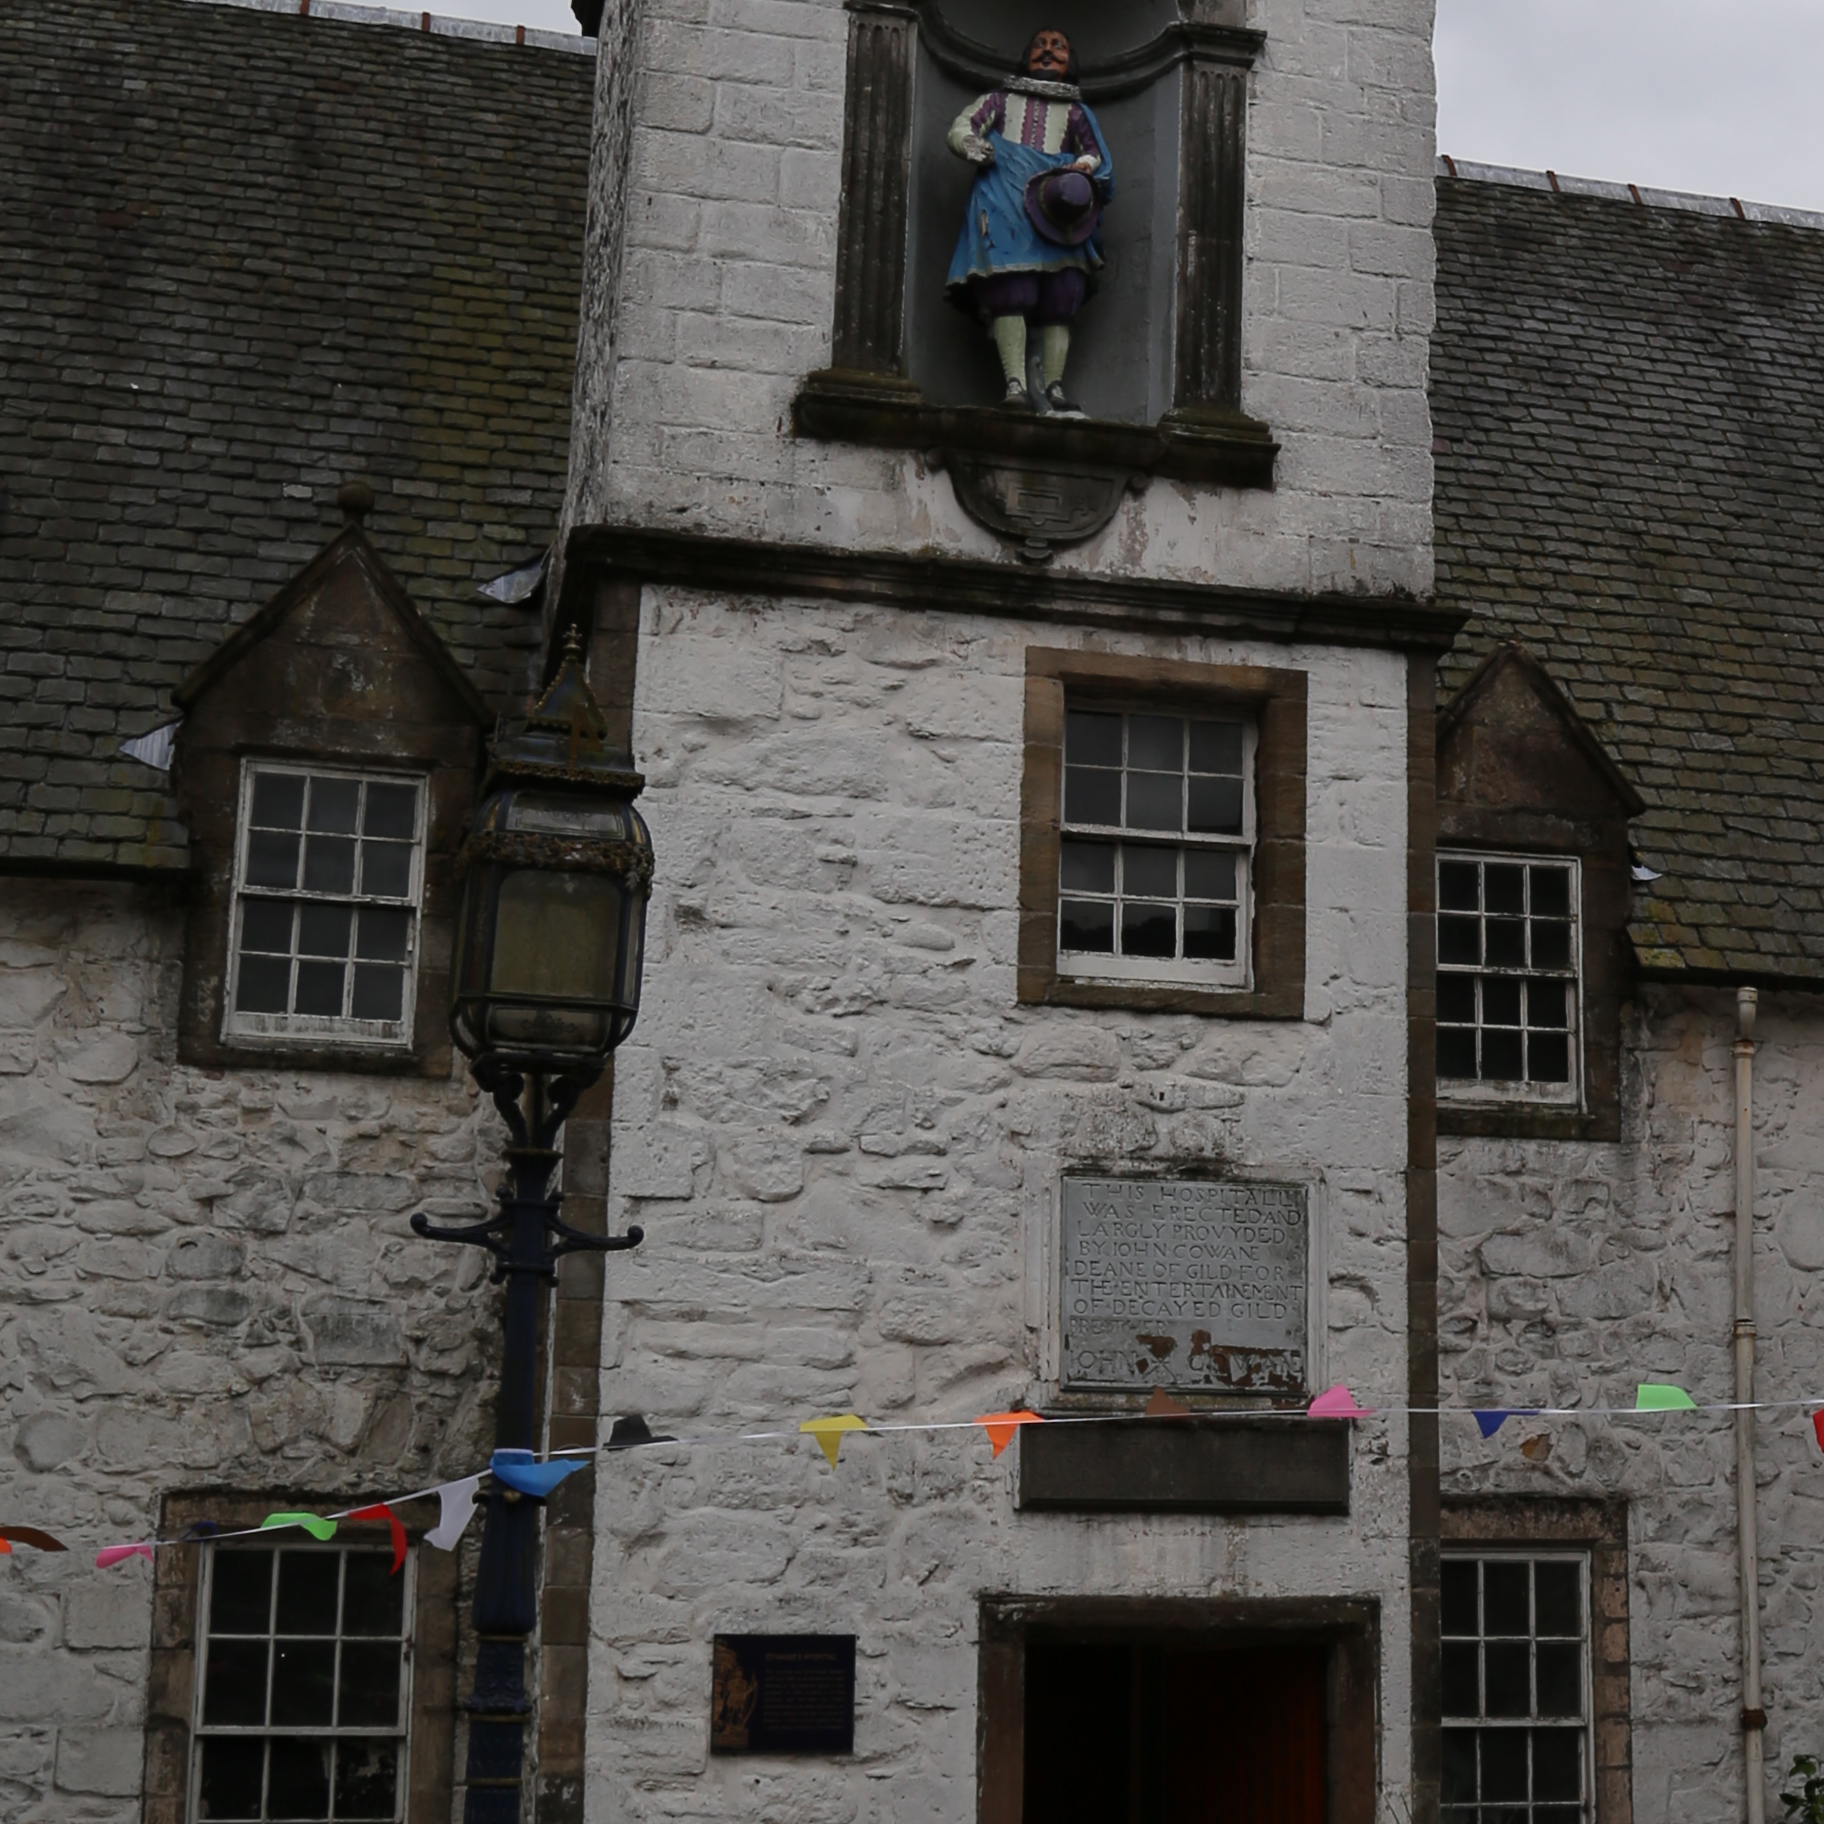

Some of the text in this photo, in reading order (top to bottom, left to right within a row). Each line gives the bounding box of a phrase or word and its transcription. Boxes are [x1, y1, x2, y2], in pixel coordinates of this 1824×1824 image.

[1082, 1183, 1294, 1208] THIS HOSPITALL
[1083, 1202, 1136, 1219] WAS
[1152, 1205, 1262, 1225] ERECTED
[1077, 1220, 1286, 1244] LARGLY PROVYDED
[1079, 1241, 1107, 1257] BY
[1173, 1244, 1260, 1261] COWANE
[1074, 1260, 1285, 1282] DEANE OF GILD FOR
[1071, 1279, 1113, 1296] THE
[1073, 1299, 1288, 1319] OF DECAYED GILD
